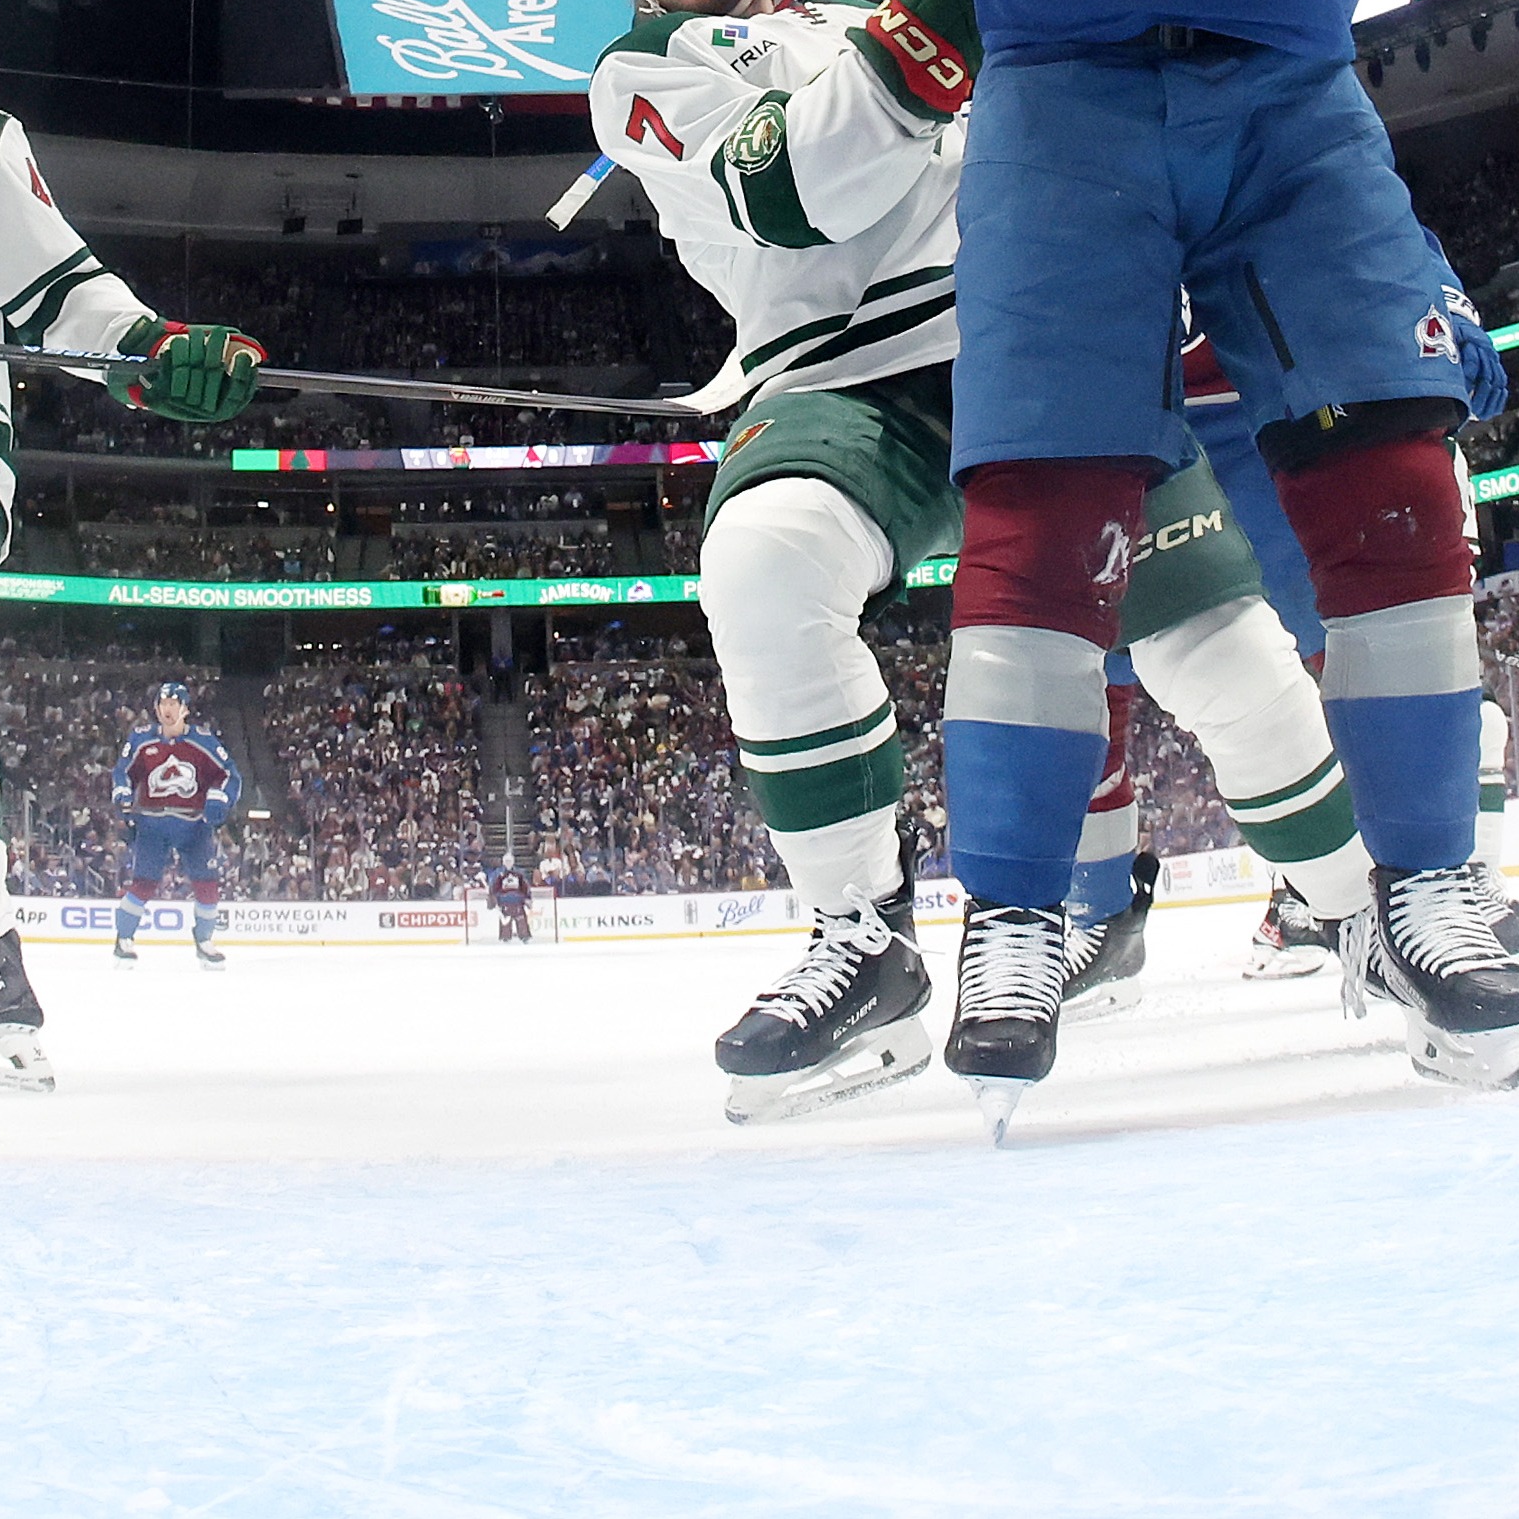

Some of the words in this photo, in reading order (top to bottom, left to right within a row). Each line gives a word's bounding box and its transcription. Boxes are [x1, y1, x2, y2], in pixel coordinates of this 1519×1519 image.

[730, 36, 779, 76] TRIA
[877, 0, 966, 92] CCM
[625, 92, 686, 162] 7
[1132, 509, 1224, 565] CCM
[107, 583, 231, 607] ALL-SEASON
[233, 586, 373, 608] SMOOTHNESS
[538, 581, 615, 605] JAMESON
[60, 905, 184, 931] GECO
[234, 908, 348, 922] NORWEGIAN
[717, 893, 767, 927] Ball
[234, 923, 284, 934] CRUISE
